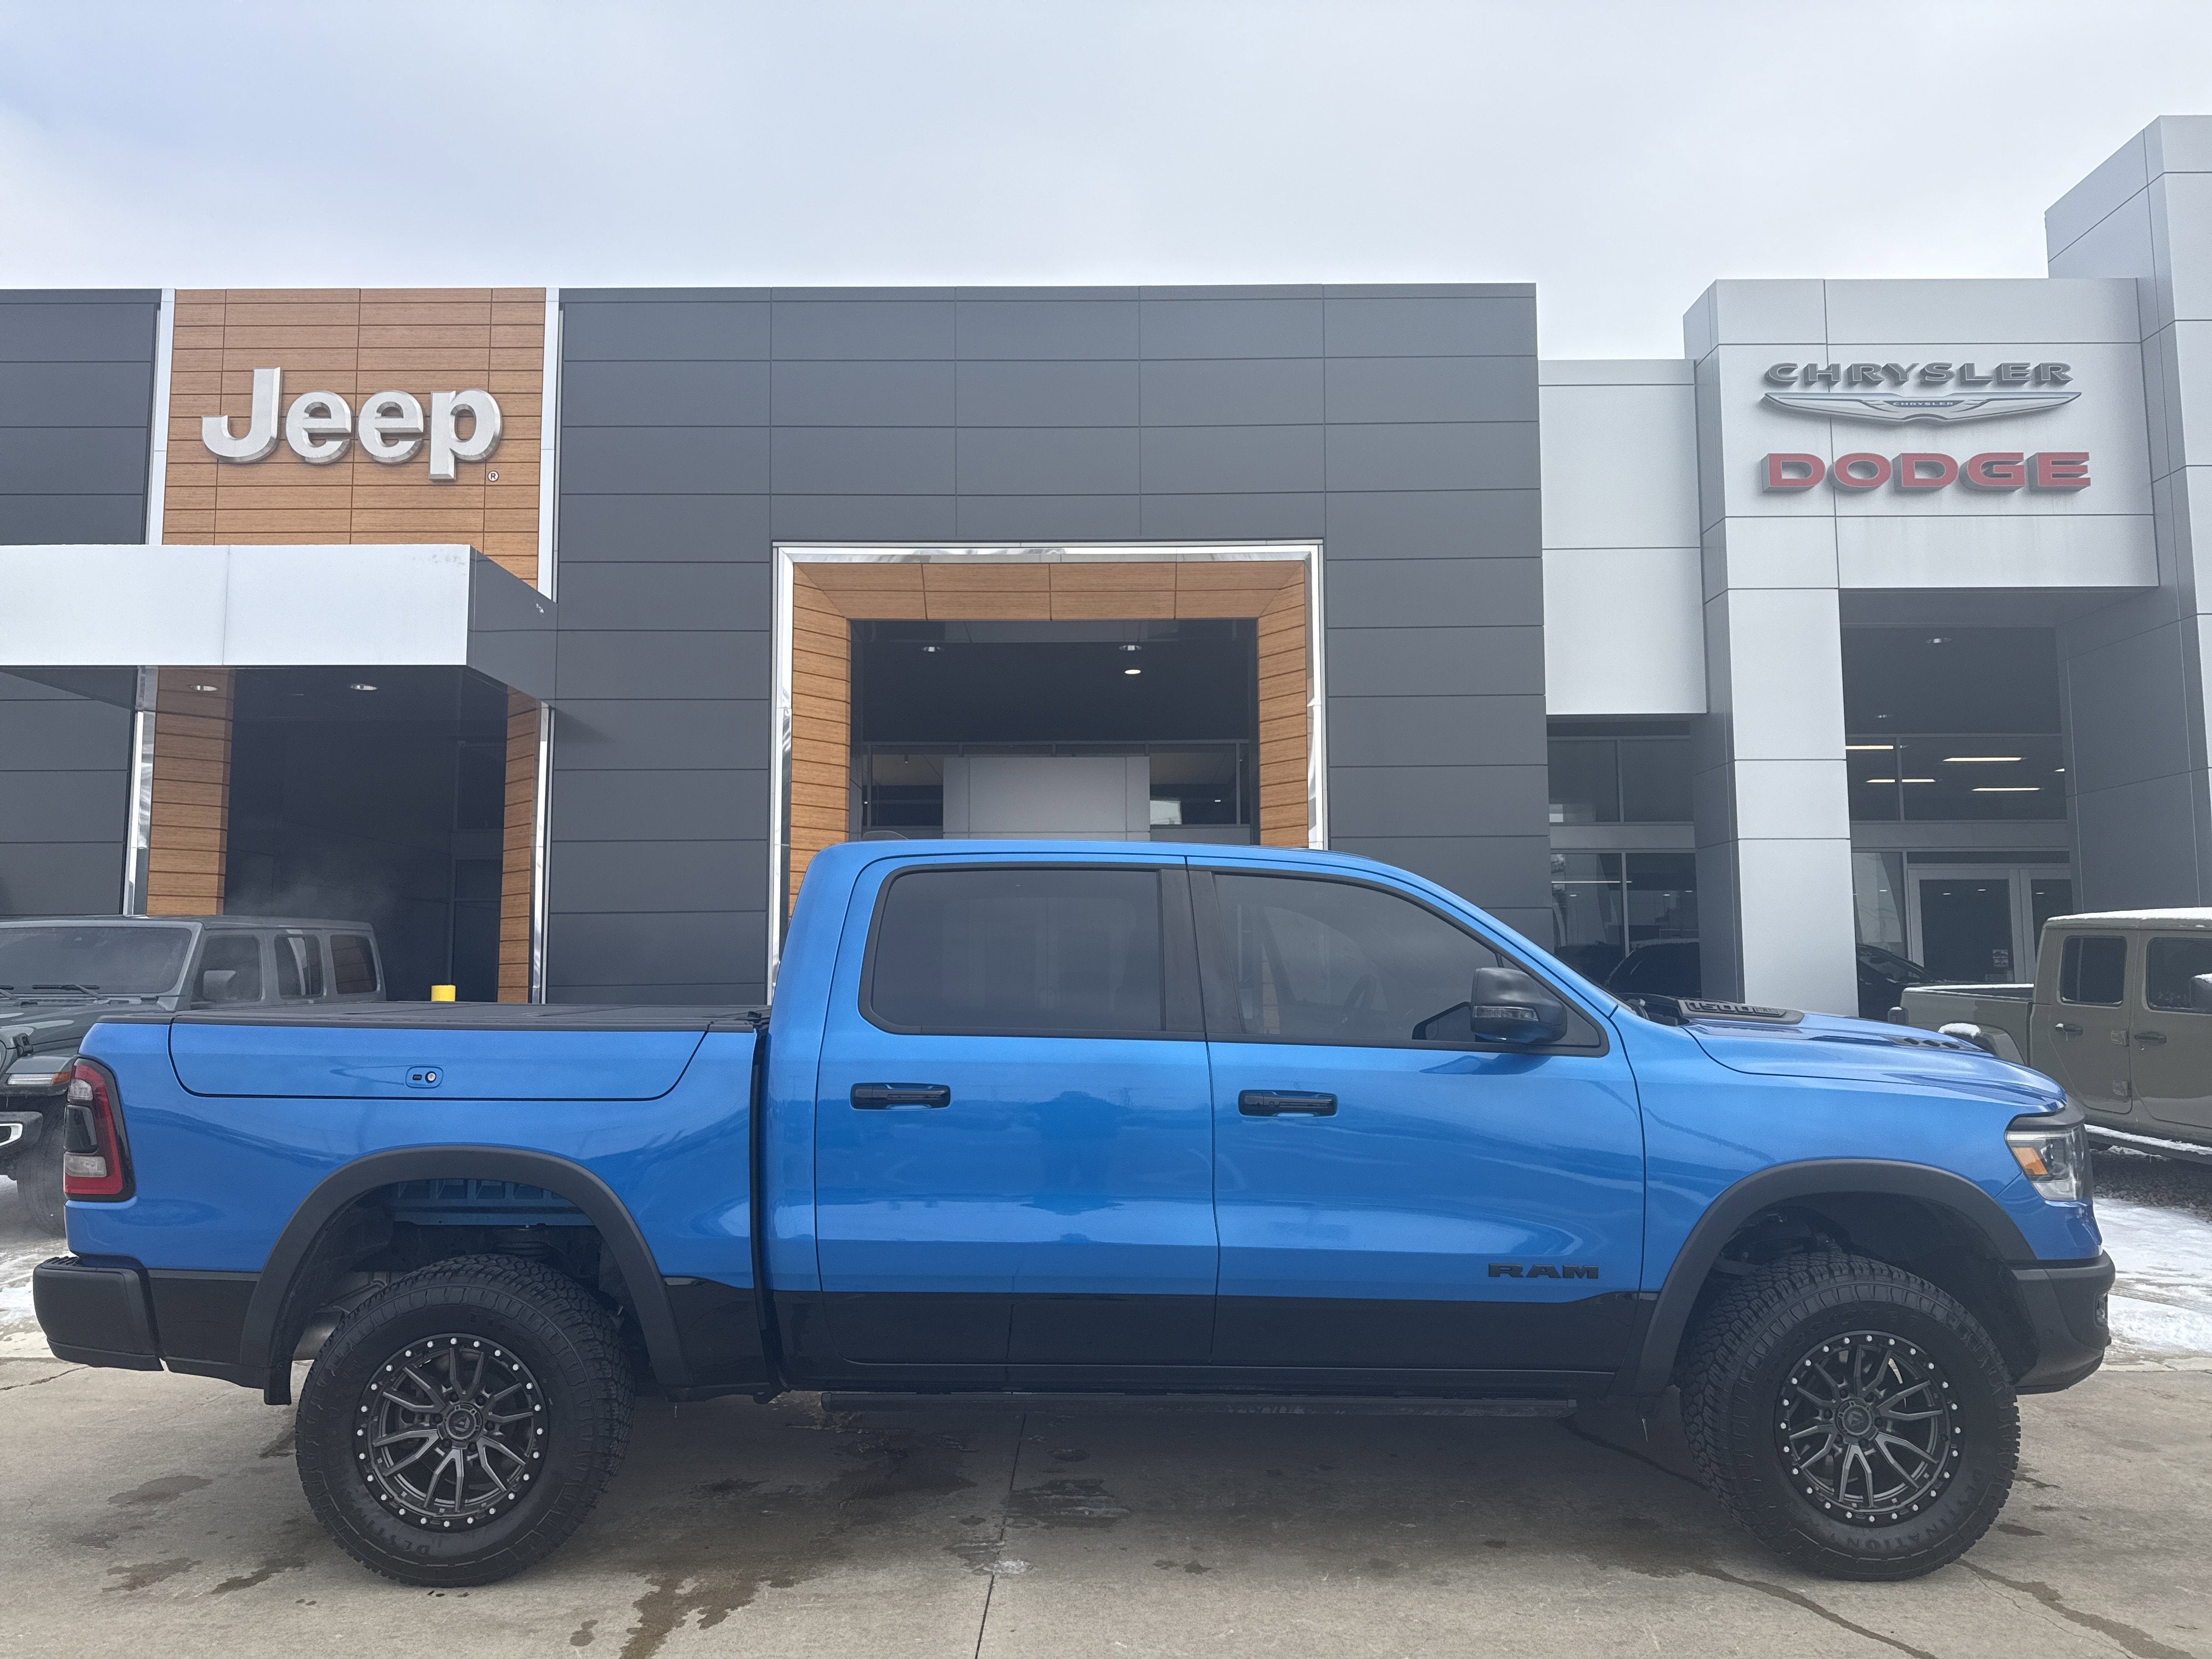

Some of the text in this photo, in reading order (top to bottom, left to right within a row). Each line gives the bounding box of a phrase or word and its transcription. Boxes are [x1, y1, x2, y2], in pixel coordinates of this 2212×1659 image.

[1764, 362, 2074, 385] CHRYSLER
[201, 366, 503, 481] Jeep
[1760, 452, 2091, 493] DODGE
[1688, 1001, 1754, 1013] 1500
[1488, 1263, 1599, 1279] RAM
